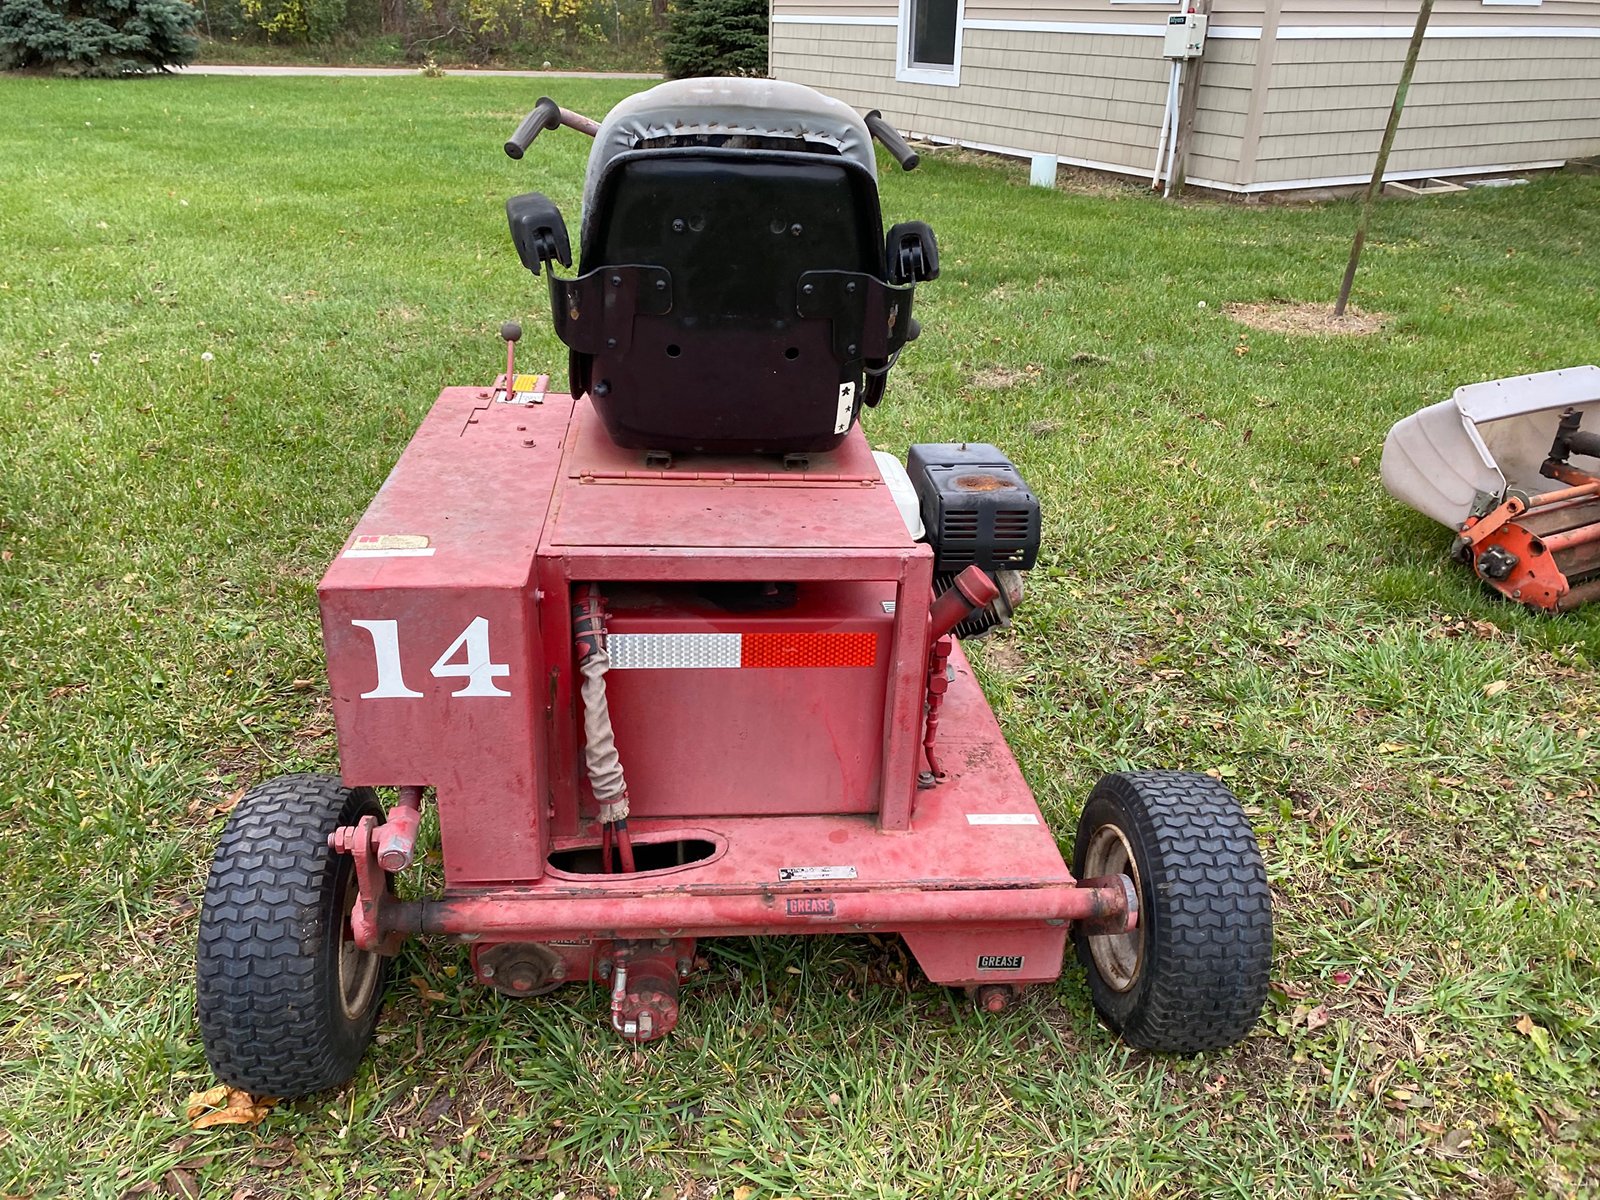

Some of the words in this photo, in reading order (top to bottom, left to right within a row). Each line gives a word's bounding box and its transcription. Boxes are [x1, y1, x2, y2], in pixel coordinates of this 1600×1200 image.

[351, 615, 512, 699] 14
[790, 899, 831, 913] GREASE
[981, 956, 1019, 967] GREASE
